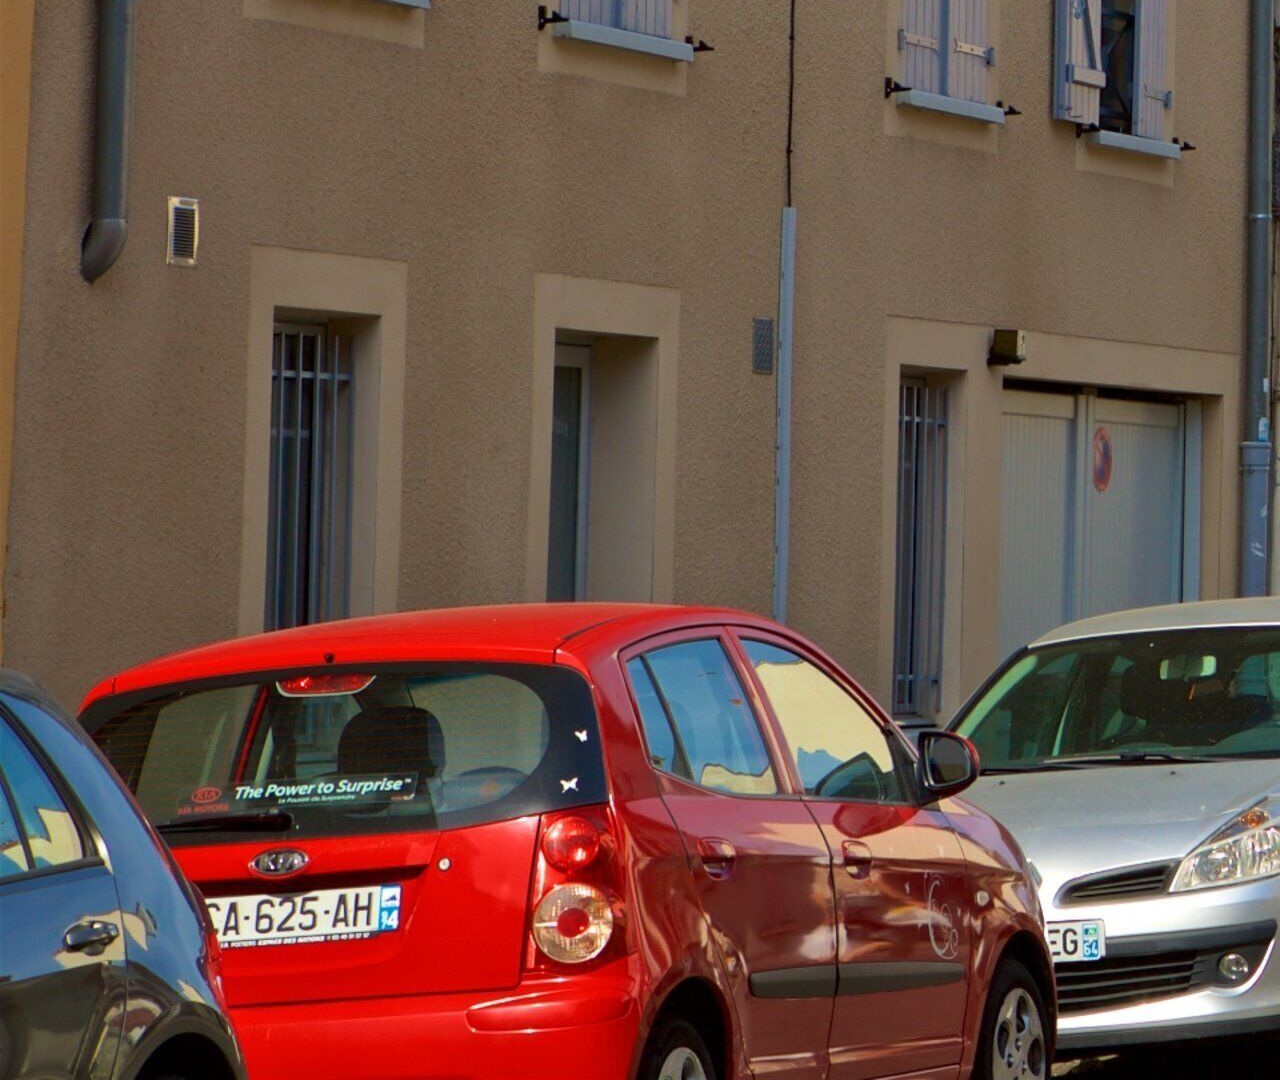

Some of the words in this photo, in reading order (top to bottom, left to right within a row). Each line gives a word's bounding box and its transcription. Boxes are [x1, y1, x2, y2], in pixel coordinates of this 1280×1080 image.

[235, 786, 262, 800] The
[264, 783, 315, 798] Power
[317, 781, 334, 793] to
[260, 852, 304, 872] KIA
[1083, 941, 1098, 956] 64
